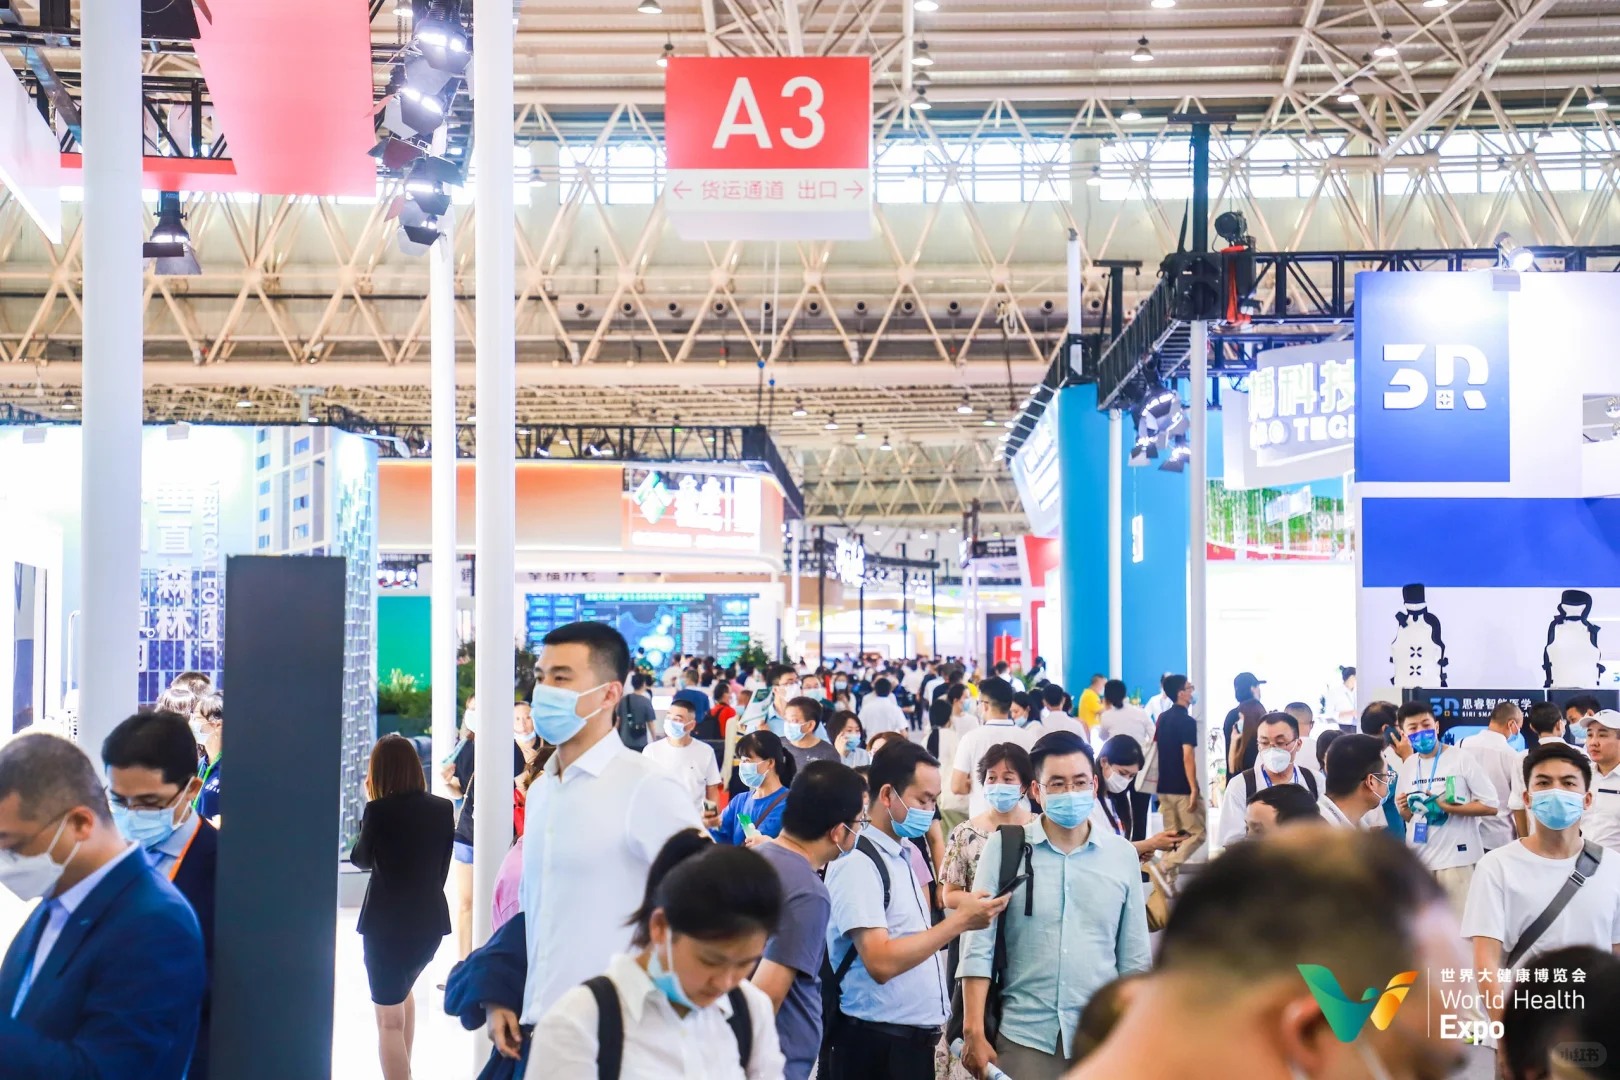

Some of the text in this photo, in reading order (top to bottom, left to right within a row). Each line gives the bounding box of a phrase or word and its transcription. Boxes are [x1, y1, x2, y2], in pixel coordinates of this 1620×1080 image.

[712, 76, 826, 149] A3
[702, 180, 838, 200] 货运通道 出口
[202, 577, 219, 650] FOREST
